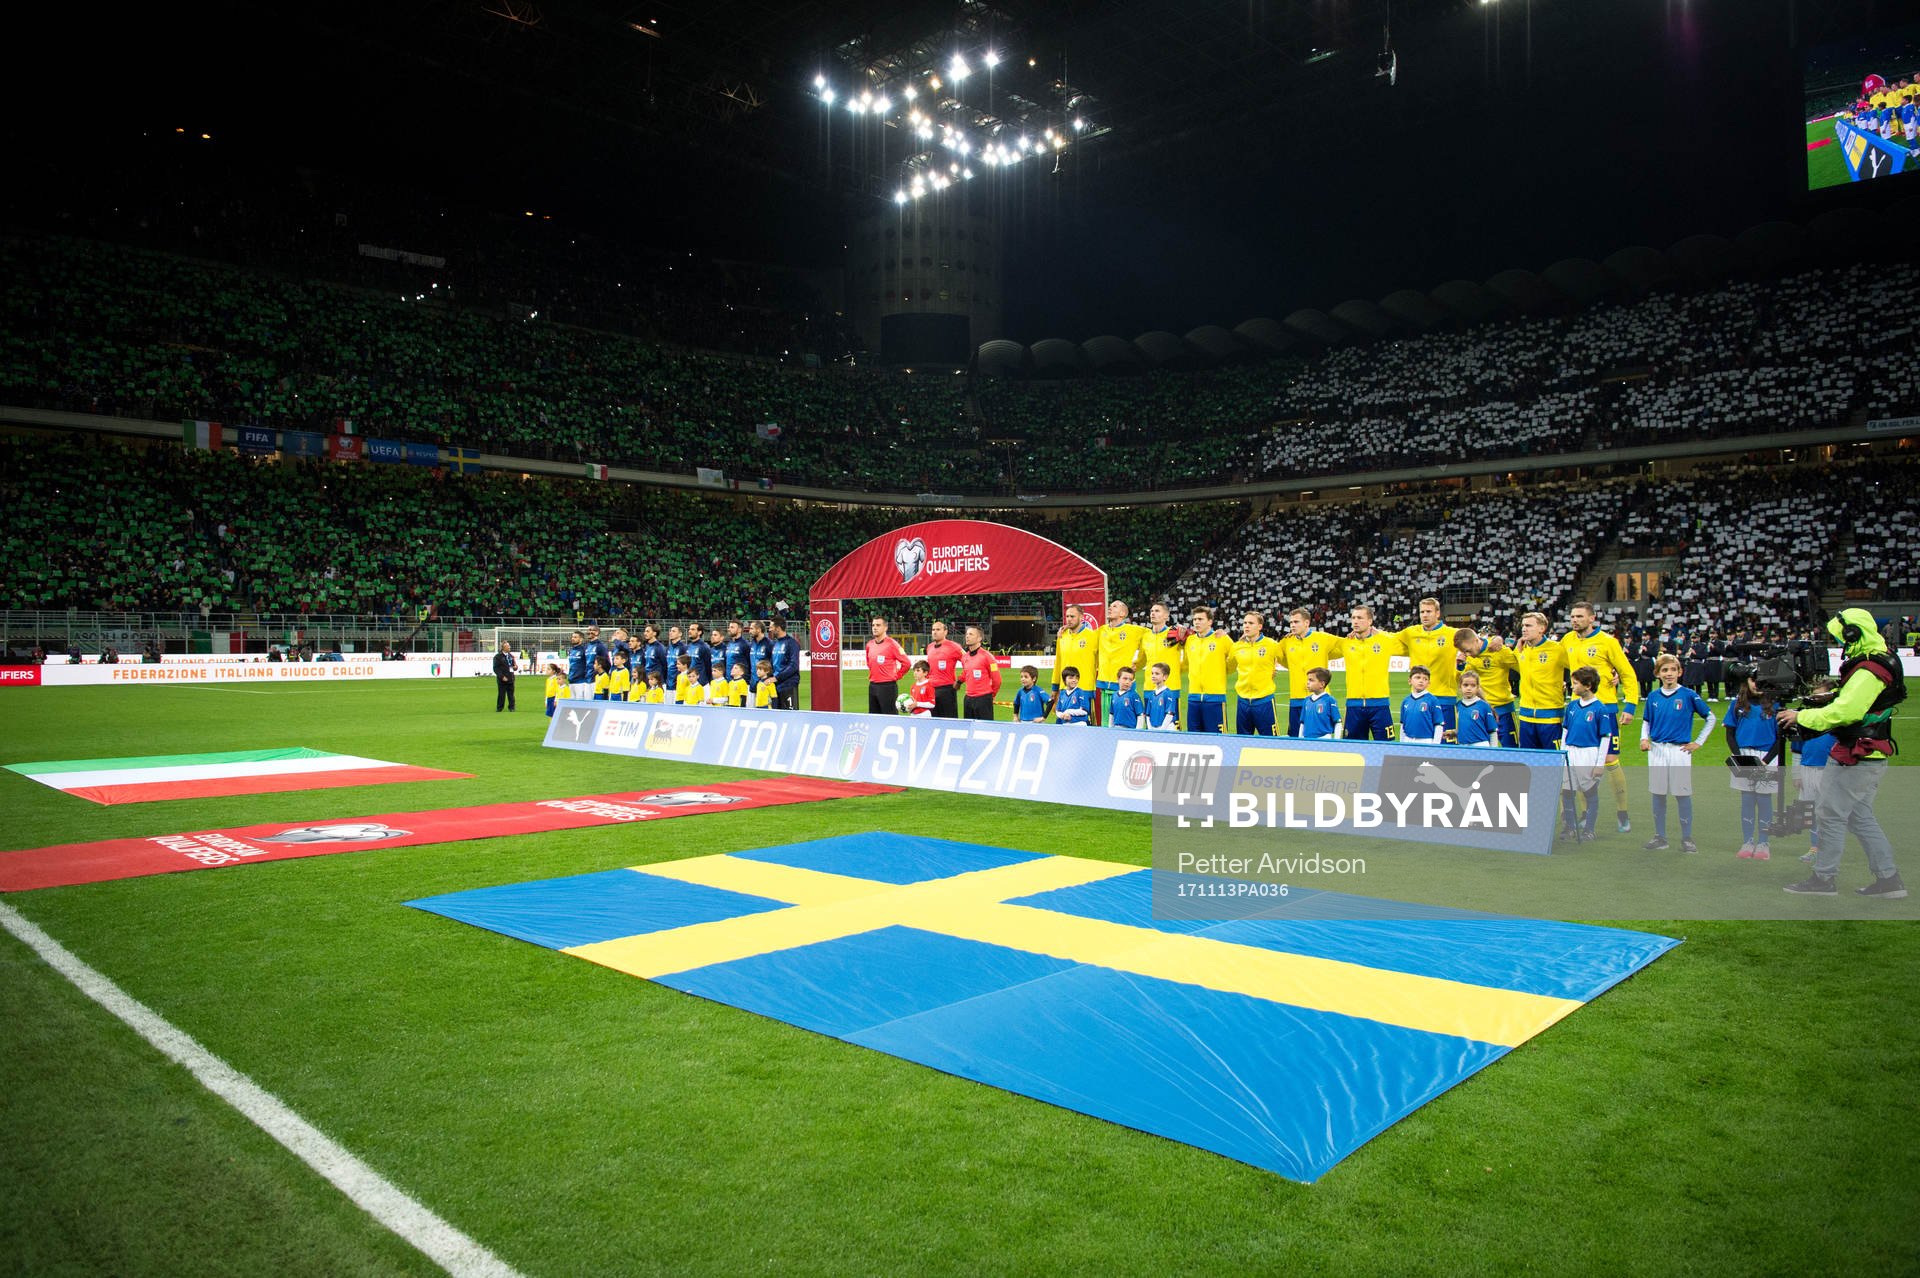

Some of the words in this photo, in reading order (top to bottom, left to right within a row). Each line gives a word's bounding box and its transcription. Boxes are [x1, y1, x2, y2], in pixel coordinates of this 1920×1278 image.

[245, 431, 269, 443] FIFA
[371, 445, 399, 458] UEFA
[932, 543, 983, 559] EUROPEAN
[926, 557, 990, 576] QUALIFIERS
[121, 632, 164, 643] PCENO
[811, 652, 838, 661] RESPECT
[0, 670, 34, 680] IFIERS
[113, 669, 207, 680] FEDERAZIONE
[215, 667, 274, 678] ITALIANA
[280, 667, 326, 677] GIUOCO
[333, 666, 374, 676] CALCIO
[786, 696, 793, 707] 1
[618, 721, 640, 738] TIM
[675, 722, 698, 739] eni
[1385, 725, 1396, 739] 13
[718, 718, 833, 774] ITALIA
[1612, 736, 1620, 751] 9
[872, 725, 1050, 795] SVEZIA
[1129, 762, 1152, 780] FIAT
[1160, 751, 1216, 797] FIAT
[145, 835, 240, 866] QUALIFIERS
[193, 833, 270, 857] EUROPEAN
